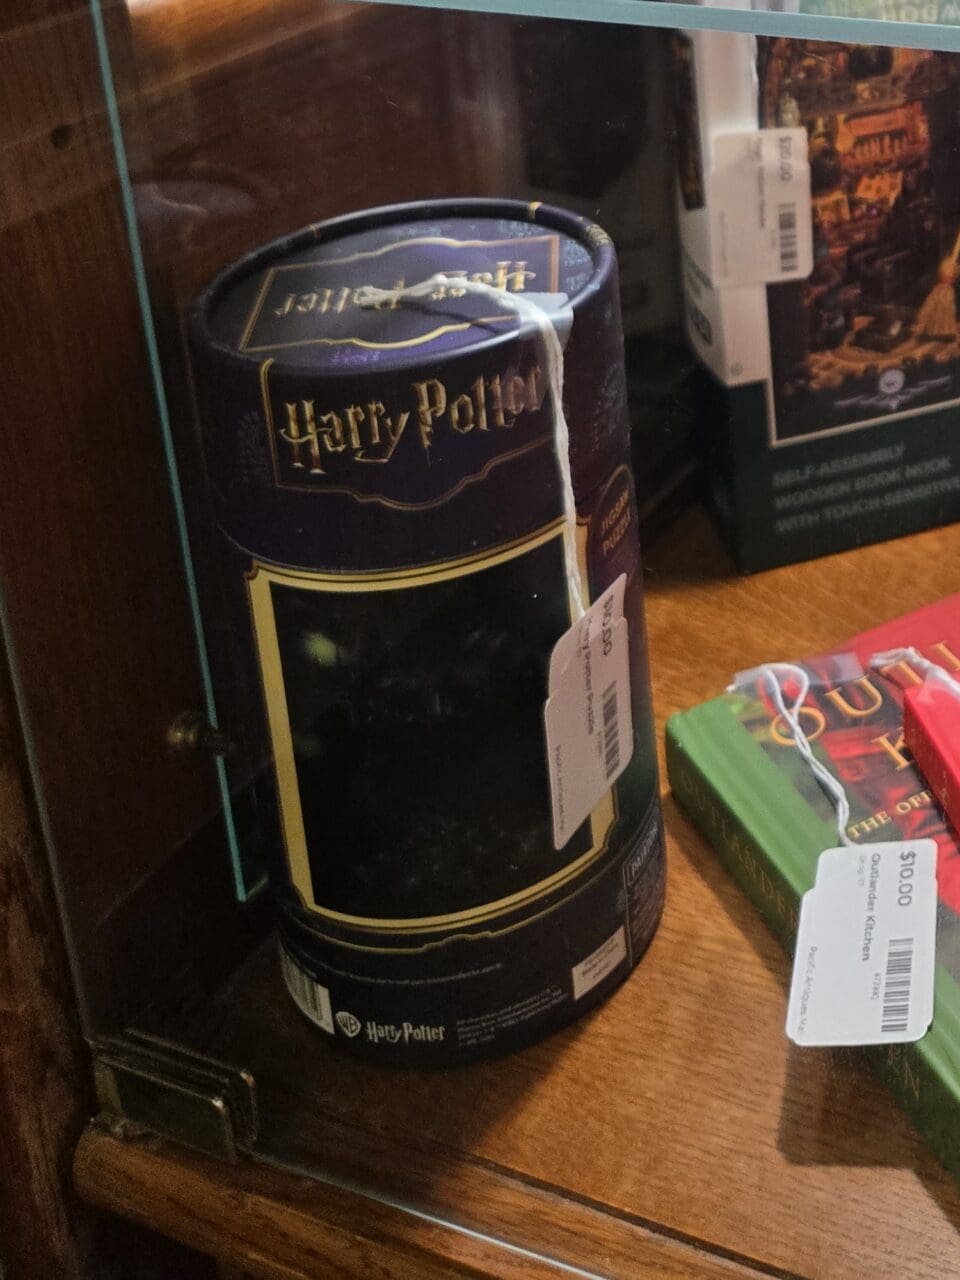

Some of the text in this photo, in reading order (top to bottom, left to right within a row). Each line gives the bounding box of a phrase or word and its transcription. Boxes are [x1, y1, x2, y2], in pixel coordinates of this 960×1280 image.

[280, 365, 542, 475] Harry Potter
[845, 804, 893, 841] THE
[861, 852, 881, 962] Outlander Kitchen
[897, 850, 919, 907] $10.00
[366, 1020, 446, 1045] Harry Potter
